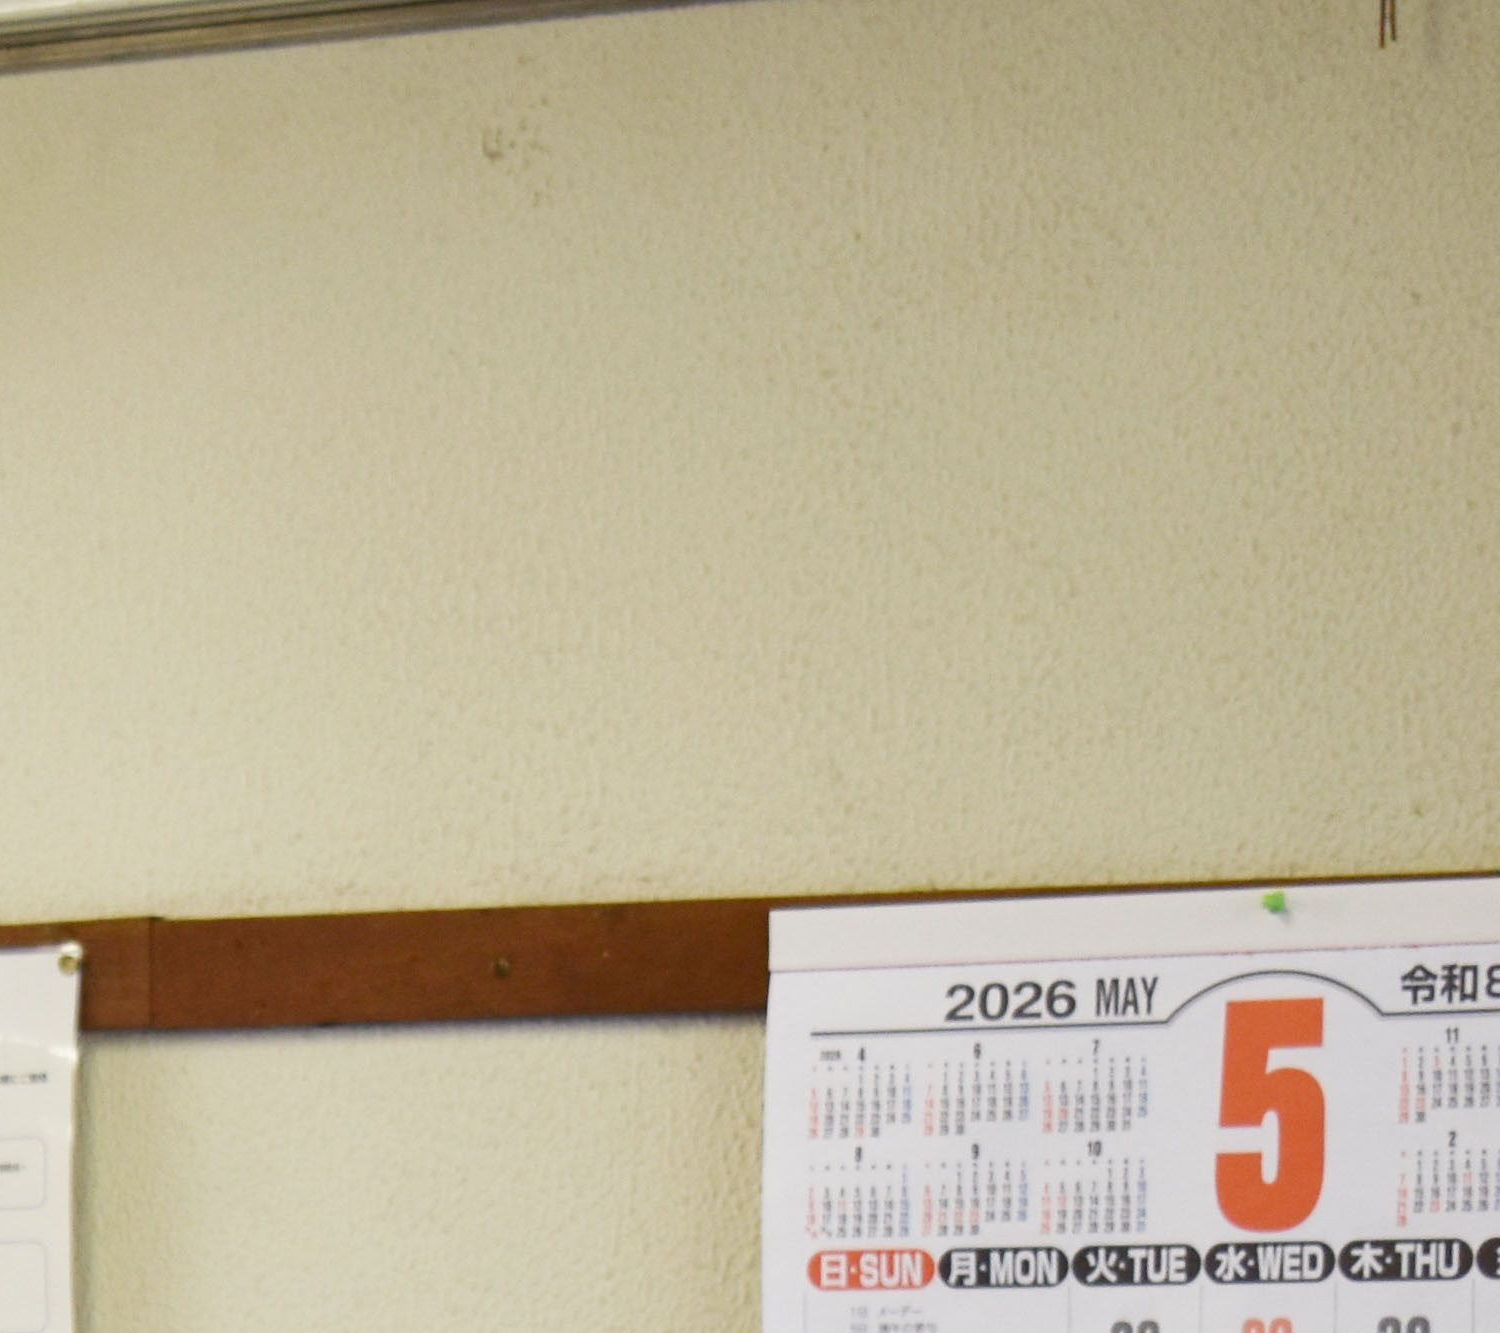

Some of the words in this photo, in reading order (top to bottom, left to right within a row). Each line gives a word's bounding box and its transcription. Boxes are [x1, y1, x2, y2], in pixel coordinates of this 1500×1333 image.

[945, 979, 1078, 1022] 2026
[1095, 976, 1160, 1017] MAY
[1445, 1028, 1460, 1044] 11
[857, 1047, 867, 1062] 4
[1214, 996, 1326, 1233] 5
[1087, 1139, 1103, 1157] 10
[1447, 1131, 1457, 1148] 2
